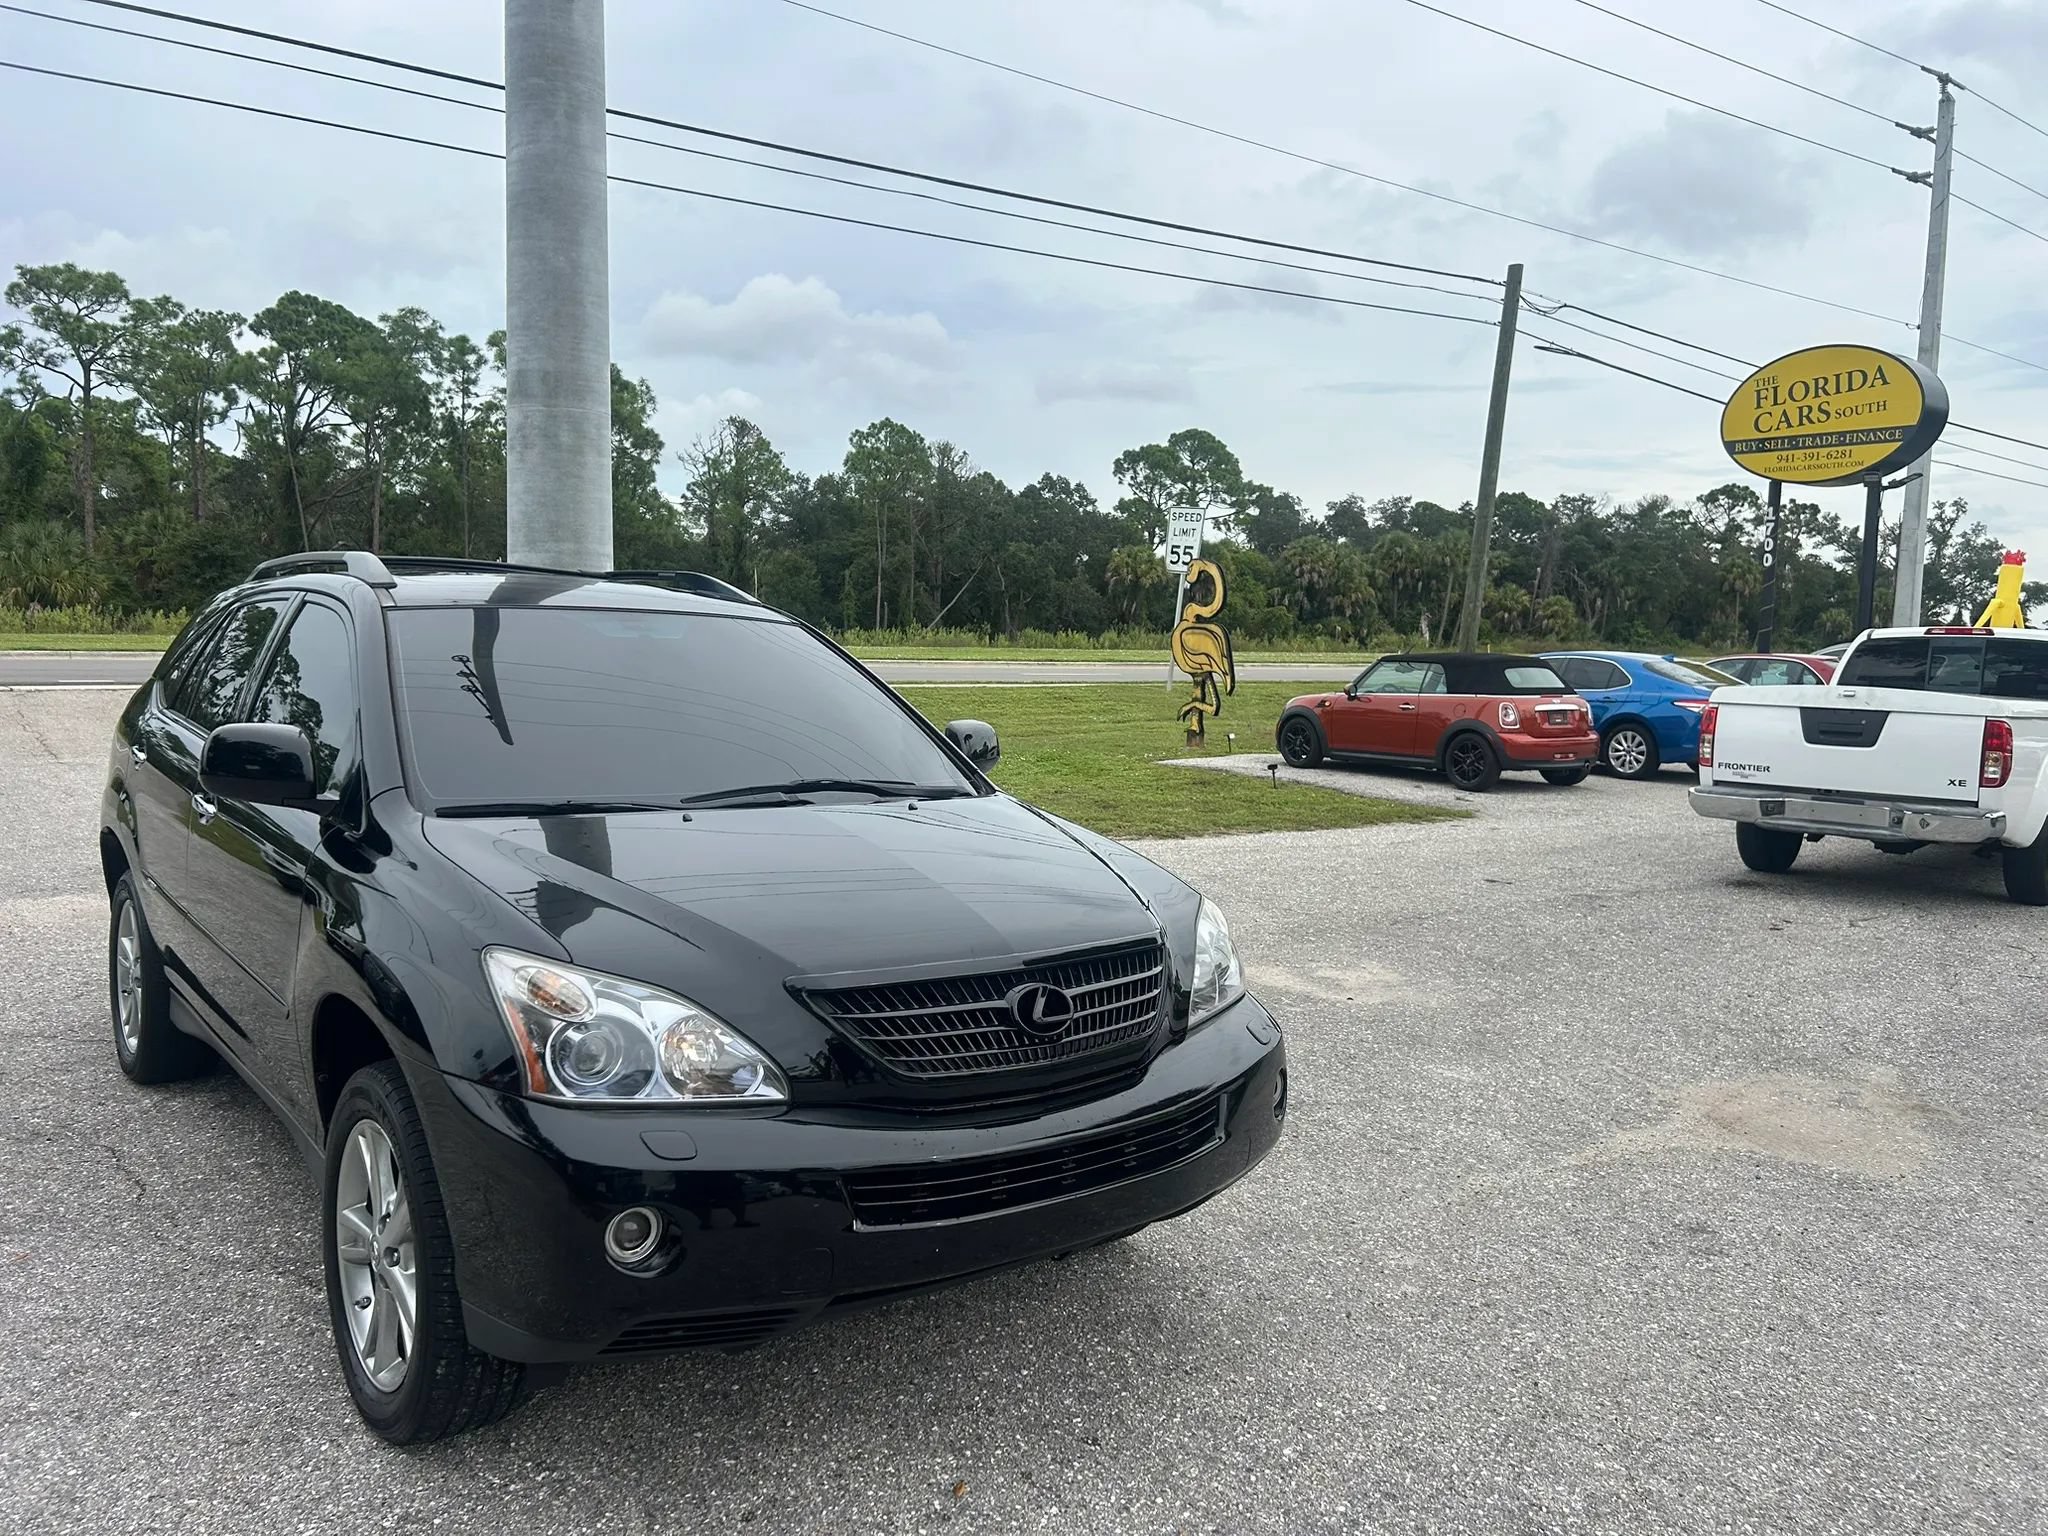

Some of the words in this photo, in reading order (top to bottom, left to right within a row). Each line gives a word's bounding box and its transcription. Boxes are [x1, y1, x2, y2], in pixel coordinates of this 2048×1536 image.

[1753, 375, 1779, 388] THE
[1753, 364, 1891, 410] FLORIDA
[1753, 400, 1831, 434] CARS
[1834, 399, 1888, 420] SOUTH
[1735, 440, 1760, 452] BUY
[1763, 438, 1791, 450] SELL
[1796, 434, 1840, 448] TRADE
[1845, 428, 1904, 444] FINANCE
[1776, 449, 1853, 464] 941-391-6281
[1763, 460, 1865, 474] FLORIDACARSSOUTH.COM
[1172, 512, 1202, 522] SPEED
[1173, 528, 1197, 537] LIMIT
[1762, 506, 1776, 567] 1700
[1170, 545, 1193, 565] 55
[1717, 761, 1771, 773] FRONTIER
[1947, 778, 1967, 788] XE
